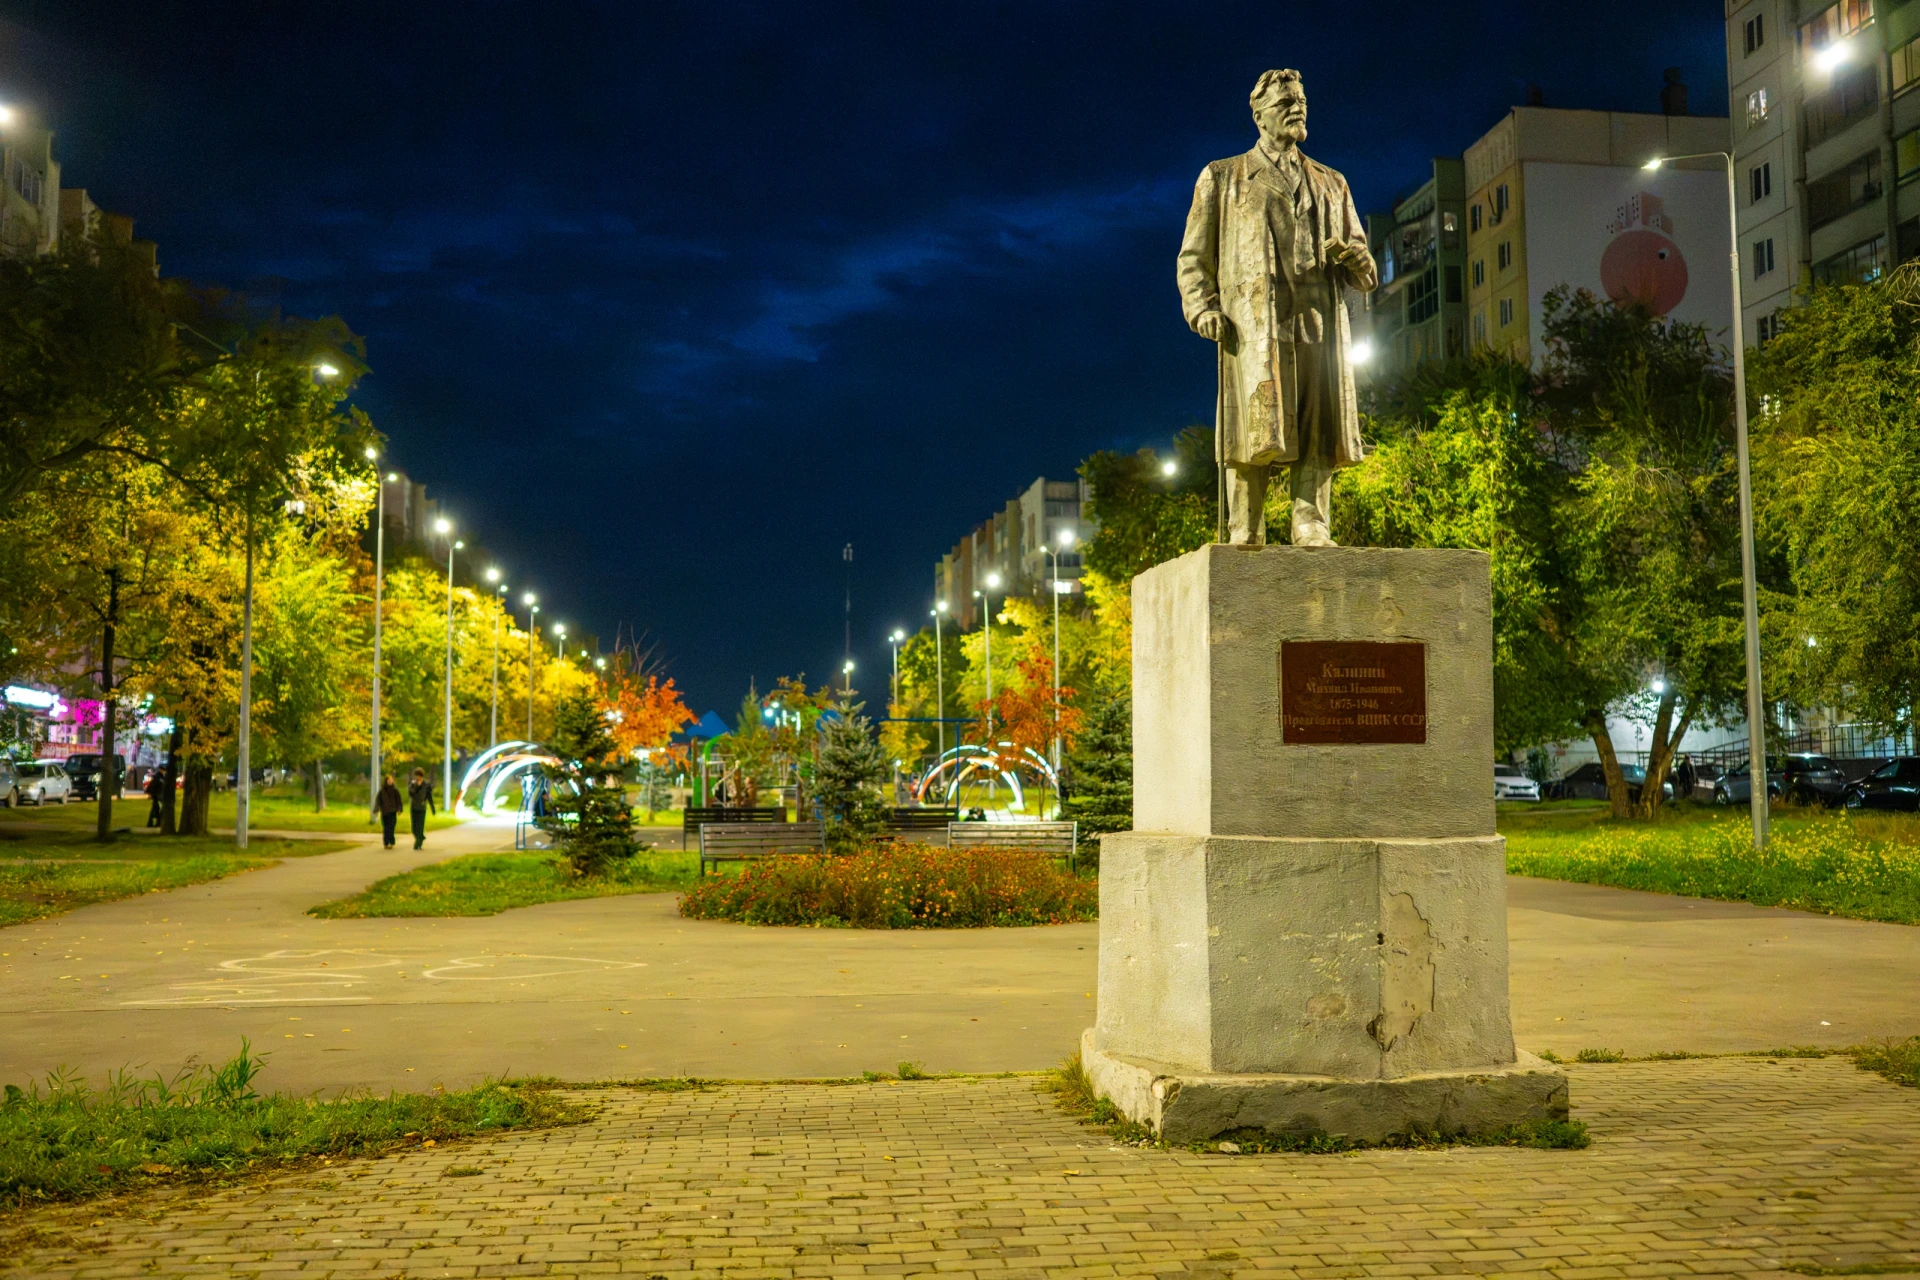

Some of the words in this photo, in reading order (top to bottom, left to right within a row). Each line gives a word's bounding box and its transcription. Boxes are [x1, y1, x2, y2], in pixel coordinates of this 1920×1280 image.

[1322, 663, 1386, 678] Калинин
[1306, 682, 1348, 694] Михаил
[1350, 682, 1404, 694] Иванович
[1329, 698, 1379, 710] 1875-1946
[1357, 714, 1391, 727] ВЦИК
[1393, 714, 1425, 726] СССР
